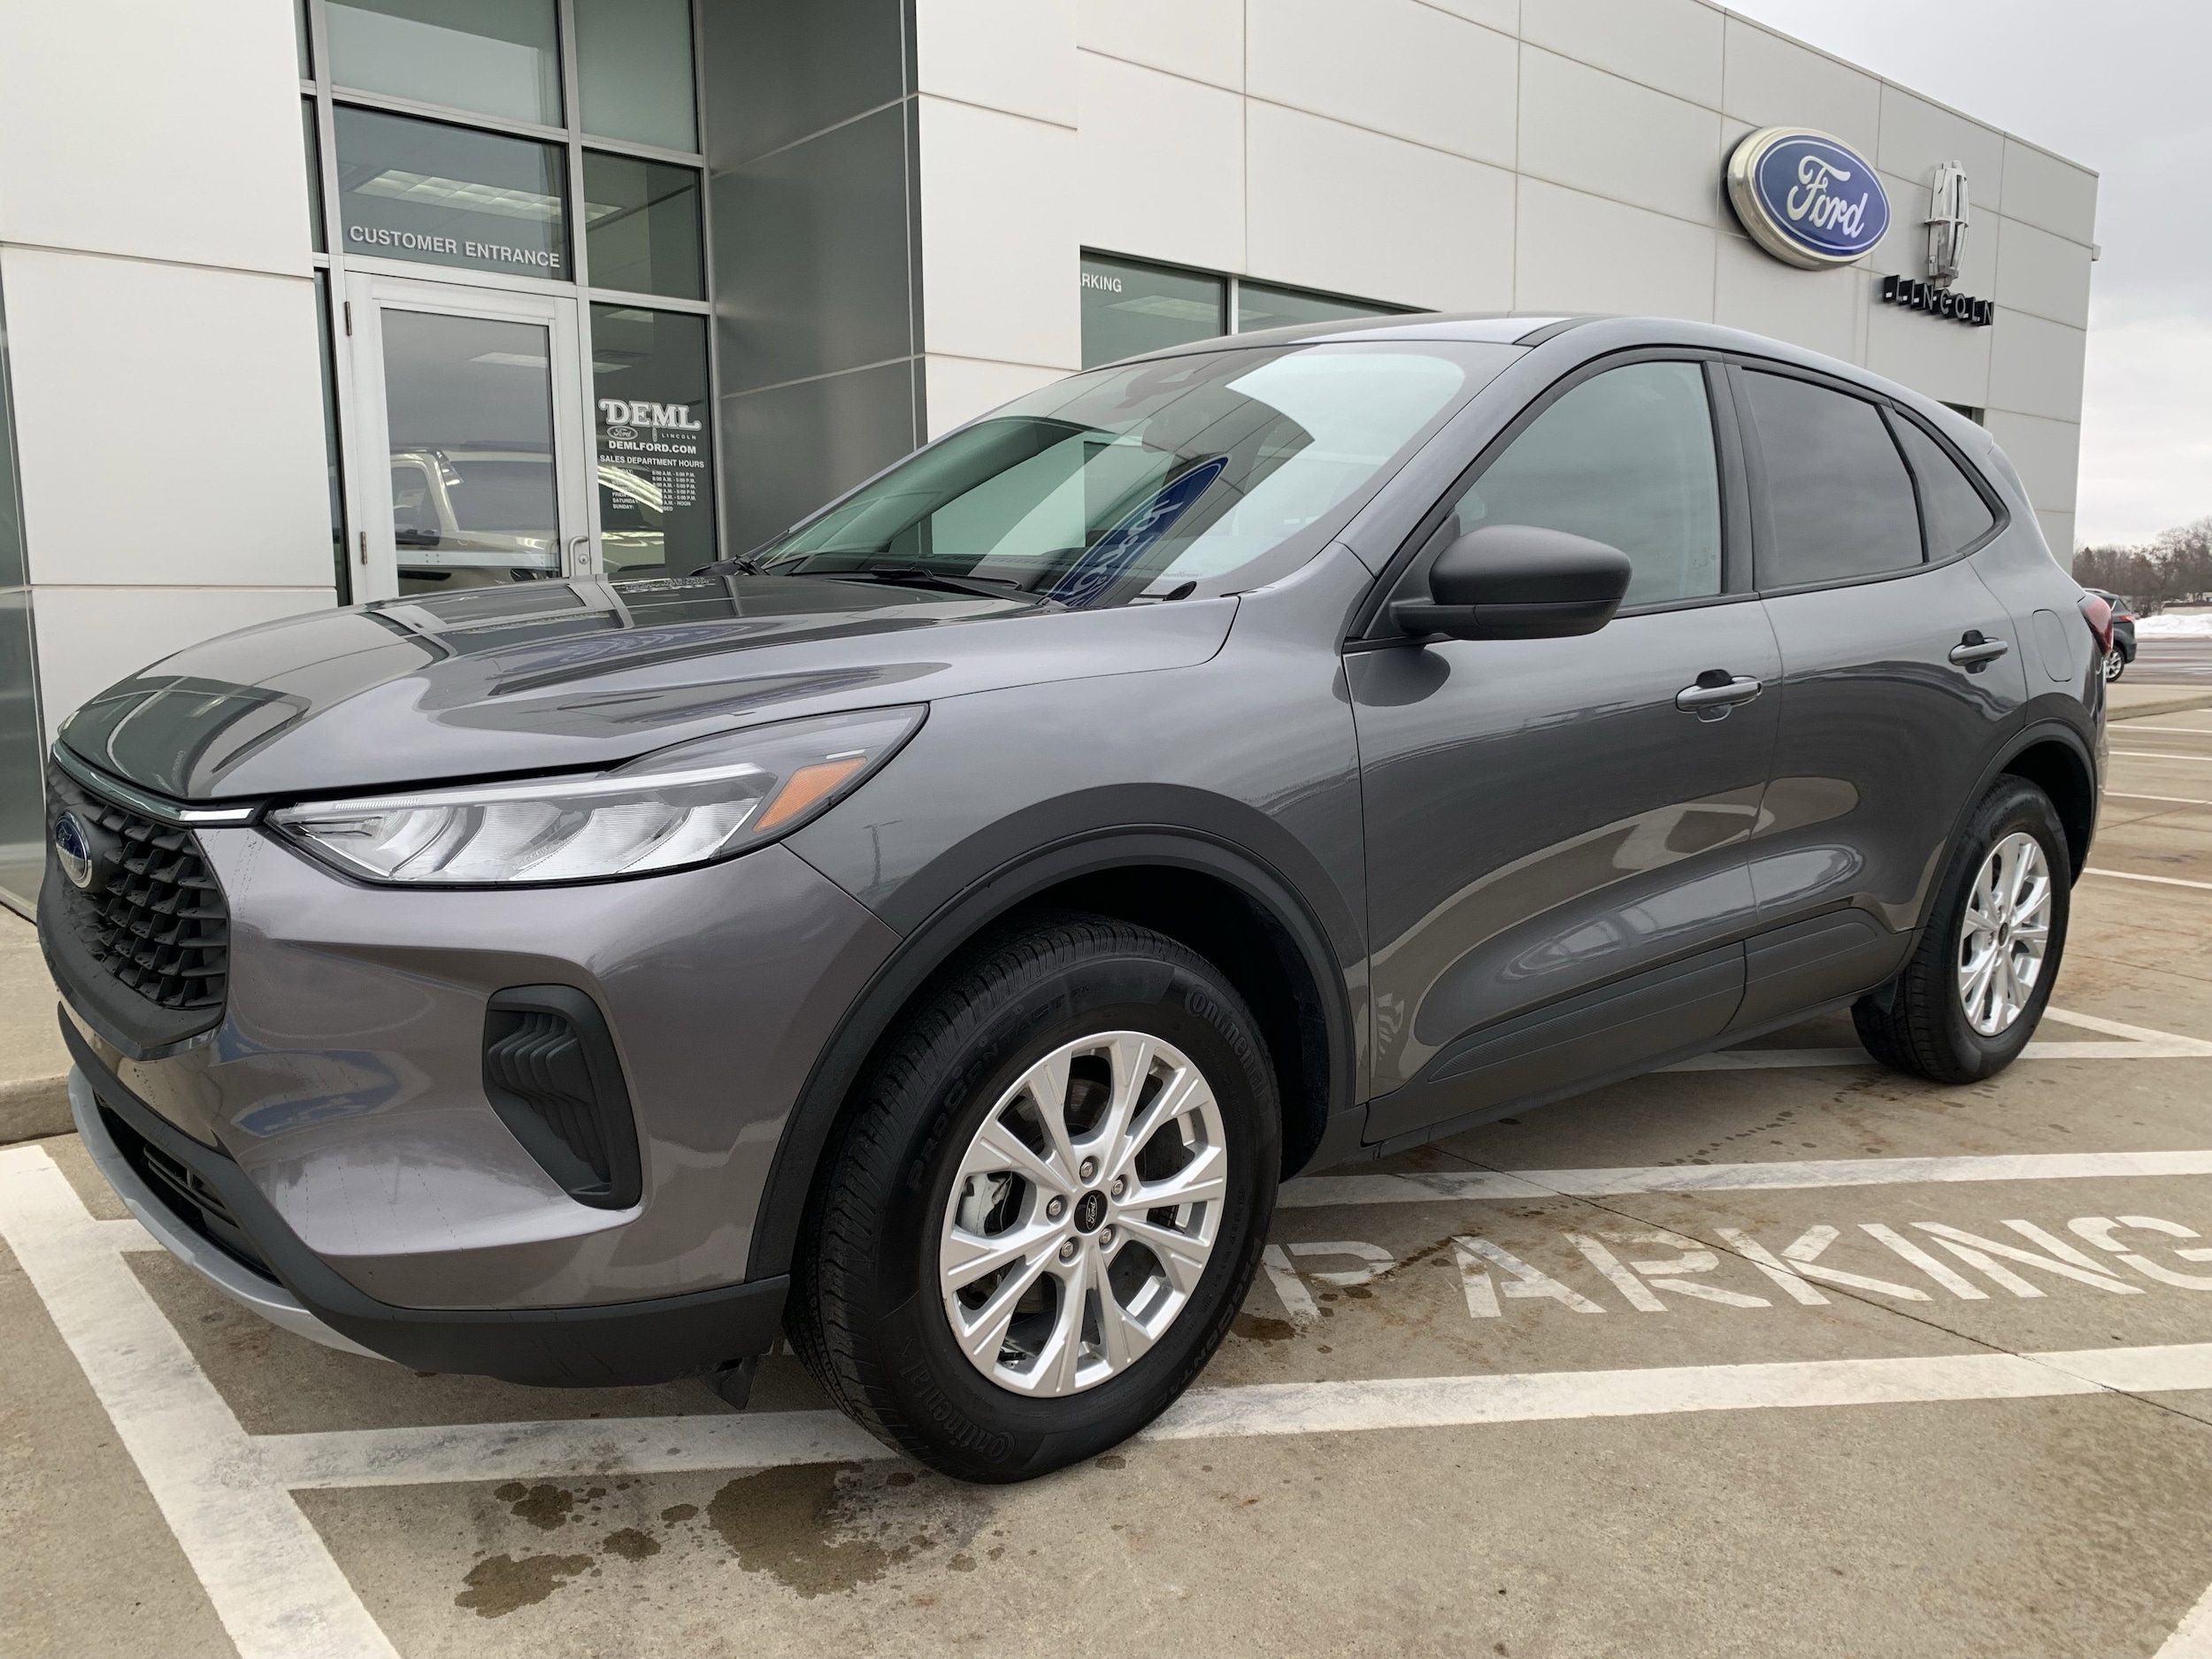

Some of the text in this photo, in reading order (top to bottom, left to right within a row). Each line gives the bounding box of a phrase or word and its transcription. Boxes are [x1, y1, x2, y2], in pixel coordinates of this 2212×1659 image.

[1786, 155, 1869, 239] Ford
[349, 225, 561, 268] CUSTOMER ENTRANCE
[1080, 273, 1122, 293] RKING
[1884, 274, 1994, 326] LINCOLN
[598, 398, 703, 431] DEML
[600, 454, 705, 468] SALES DEPARTMENT HOURS
[609, 440, 697, 455] DEMLFORD.COM
[1261, 1215, 2212, 1324] PARKING
